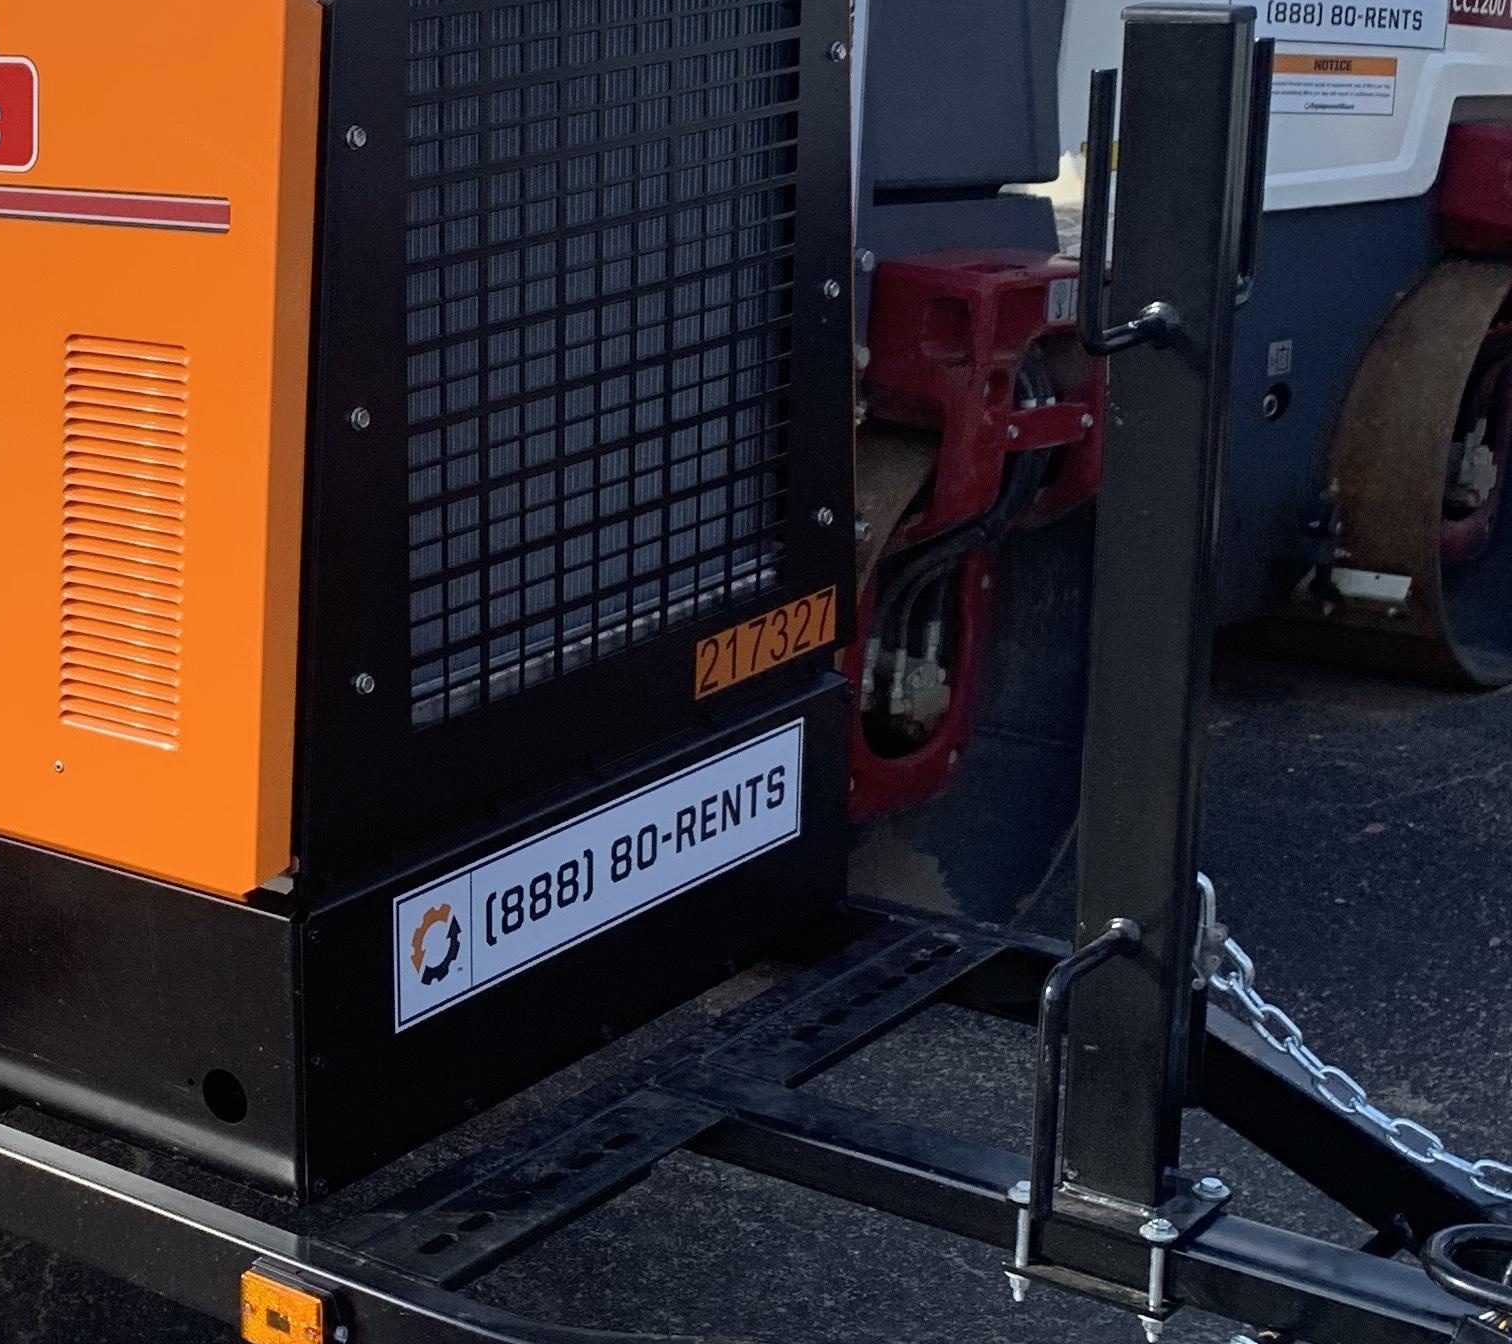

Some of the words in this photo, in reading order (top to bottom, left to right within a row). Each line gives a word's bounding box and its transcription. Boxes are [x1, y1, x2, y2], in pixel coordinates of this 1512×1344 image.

[1267, 0, 1323, 27] (888)
[1330, 5, 1423, 31] 80-RENTS
[1314, 59, 1352, 72] NOTICE
[699, 588, 834, 694] 217327
[485, 848, 594, 947] (888)
[610, 765, 785, 883] 80-RENTS
